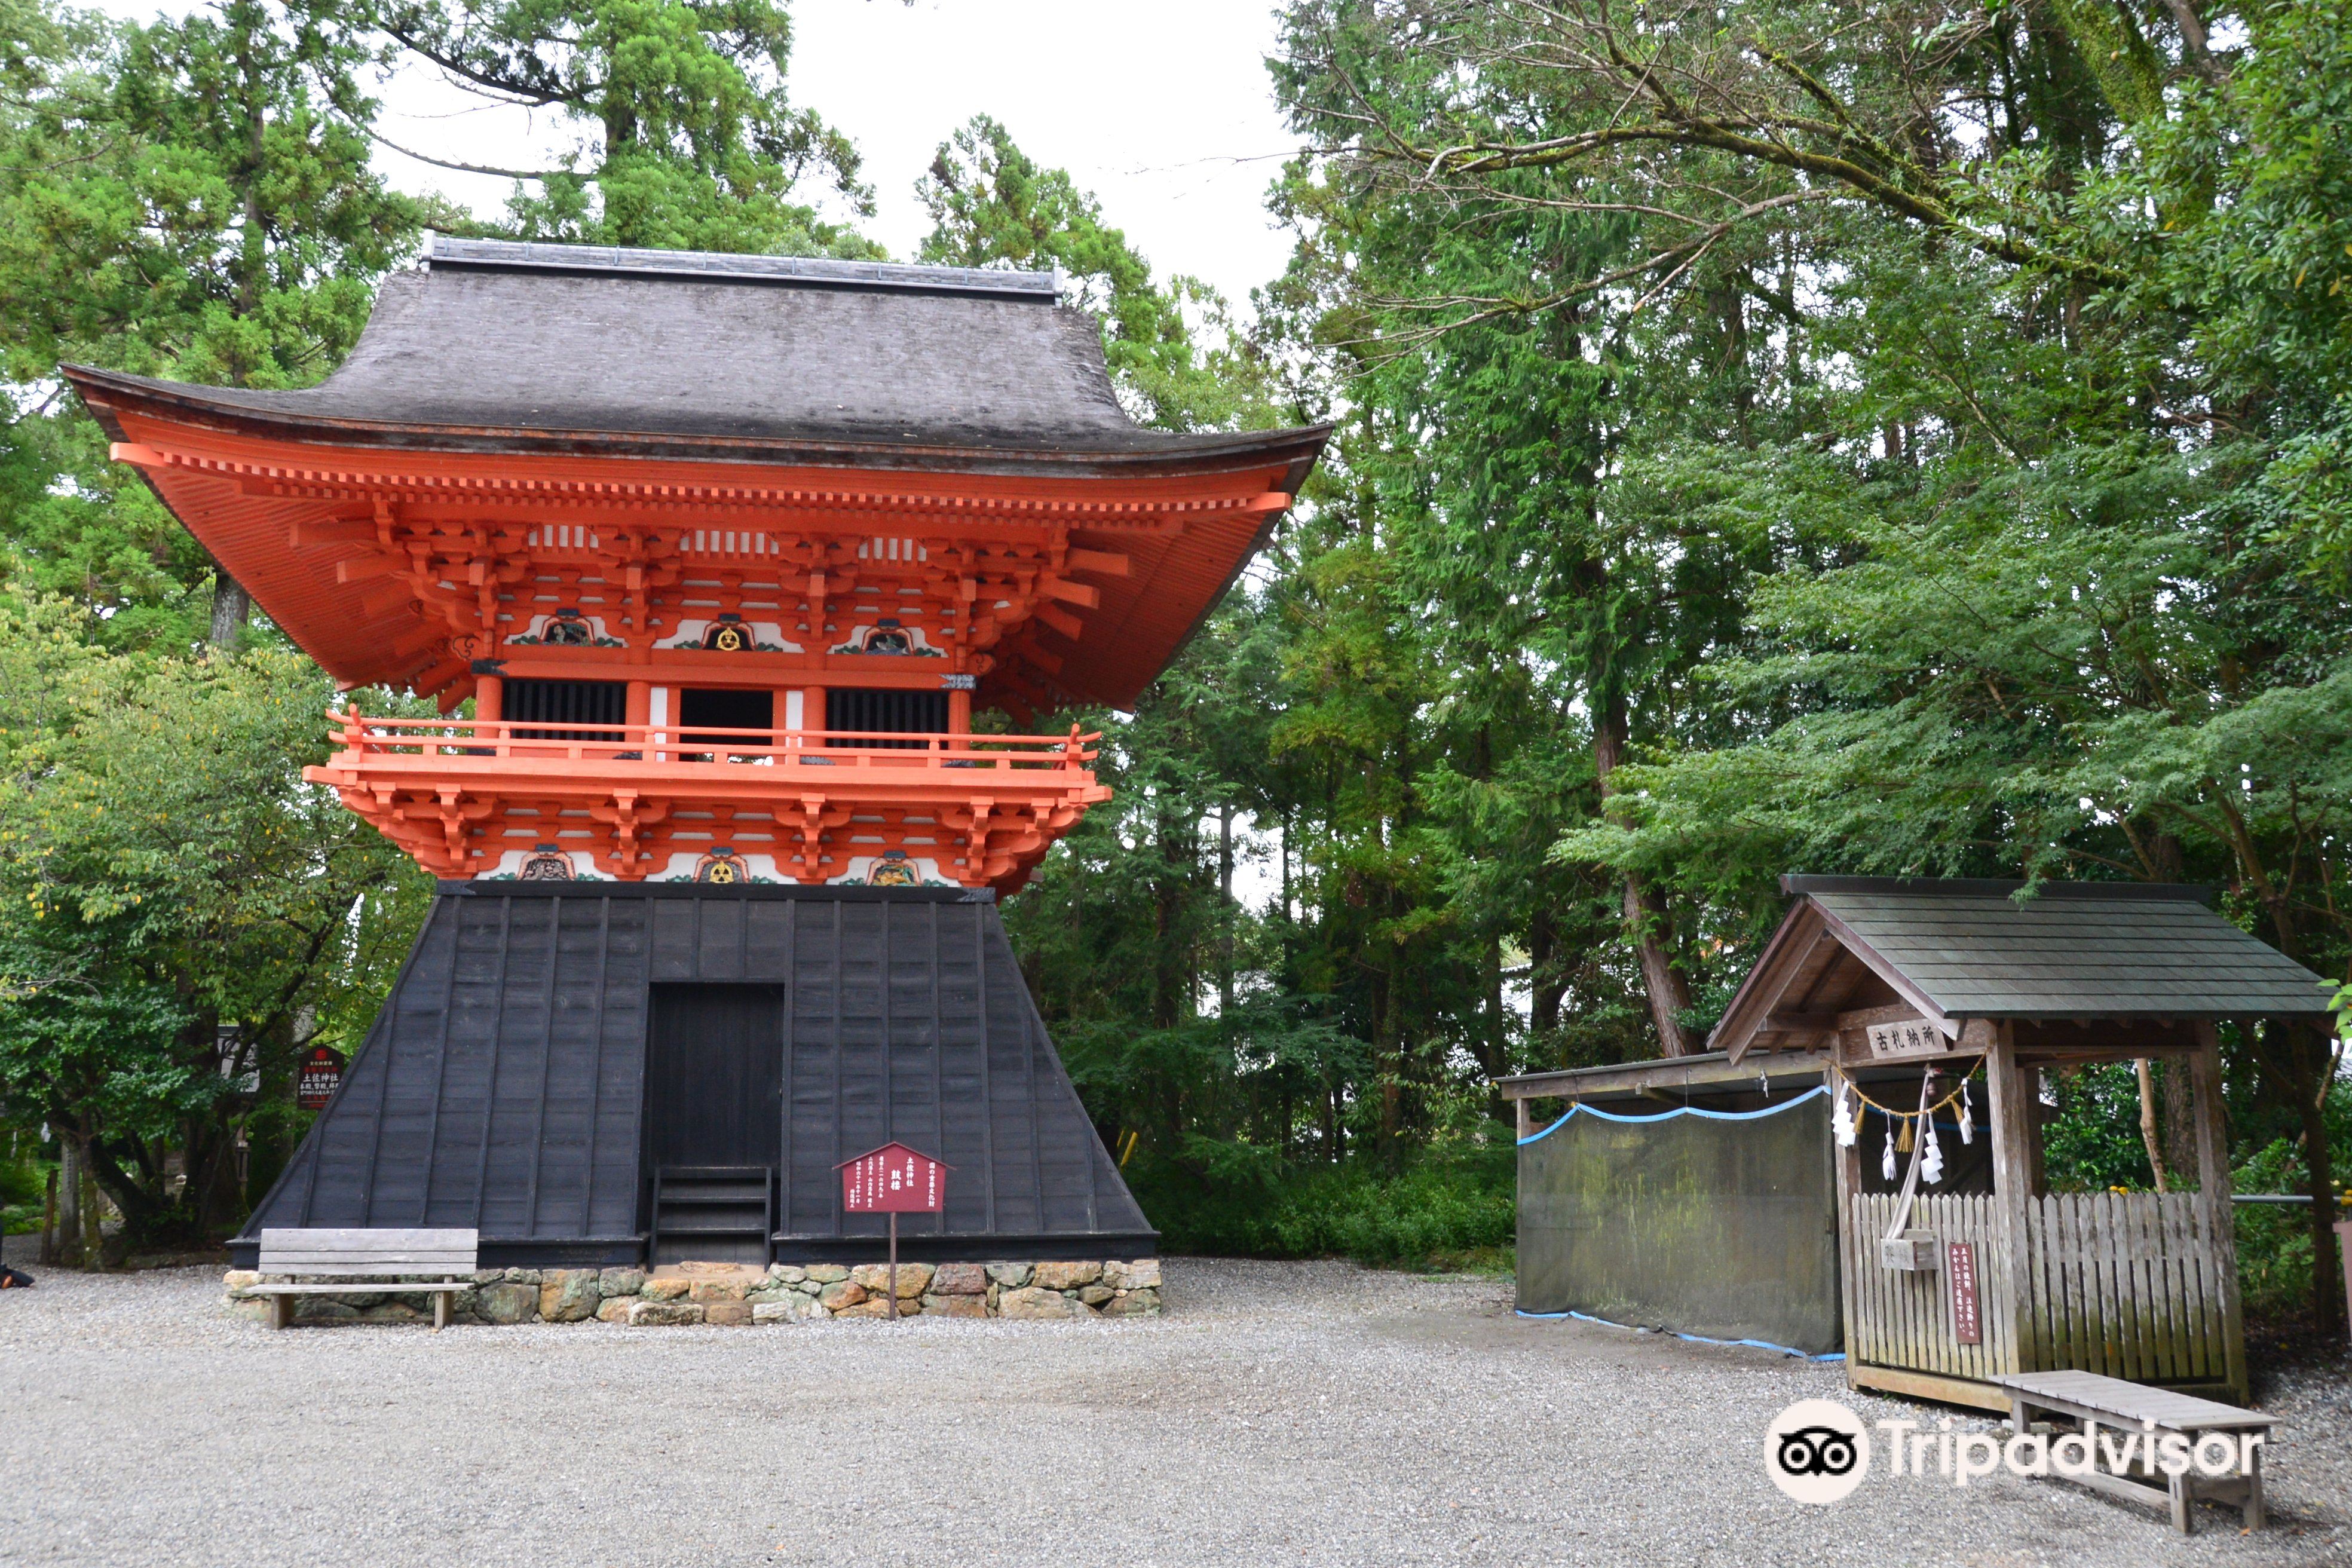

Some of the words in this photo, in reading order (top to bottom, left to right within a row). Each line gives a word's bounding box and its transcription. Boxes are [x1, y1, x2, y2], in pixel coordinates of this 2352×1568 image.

[1876, 1025, 1936, 1051] 古札納所
[303, 1073, 338, 1082] 土佐神社
[890, 1169, 902, 1190] 鼓楼
[906, 1156, 914, 1187] 土佐神社
